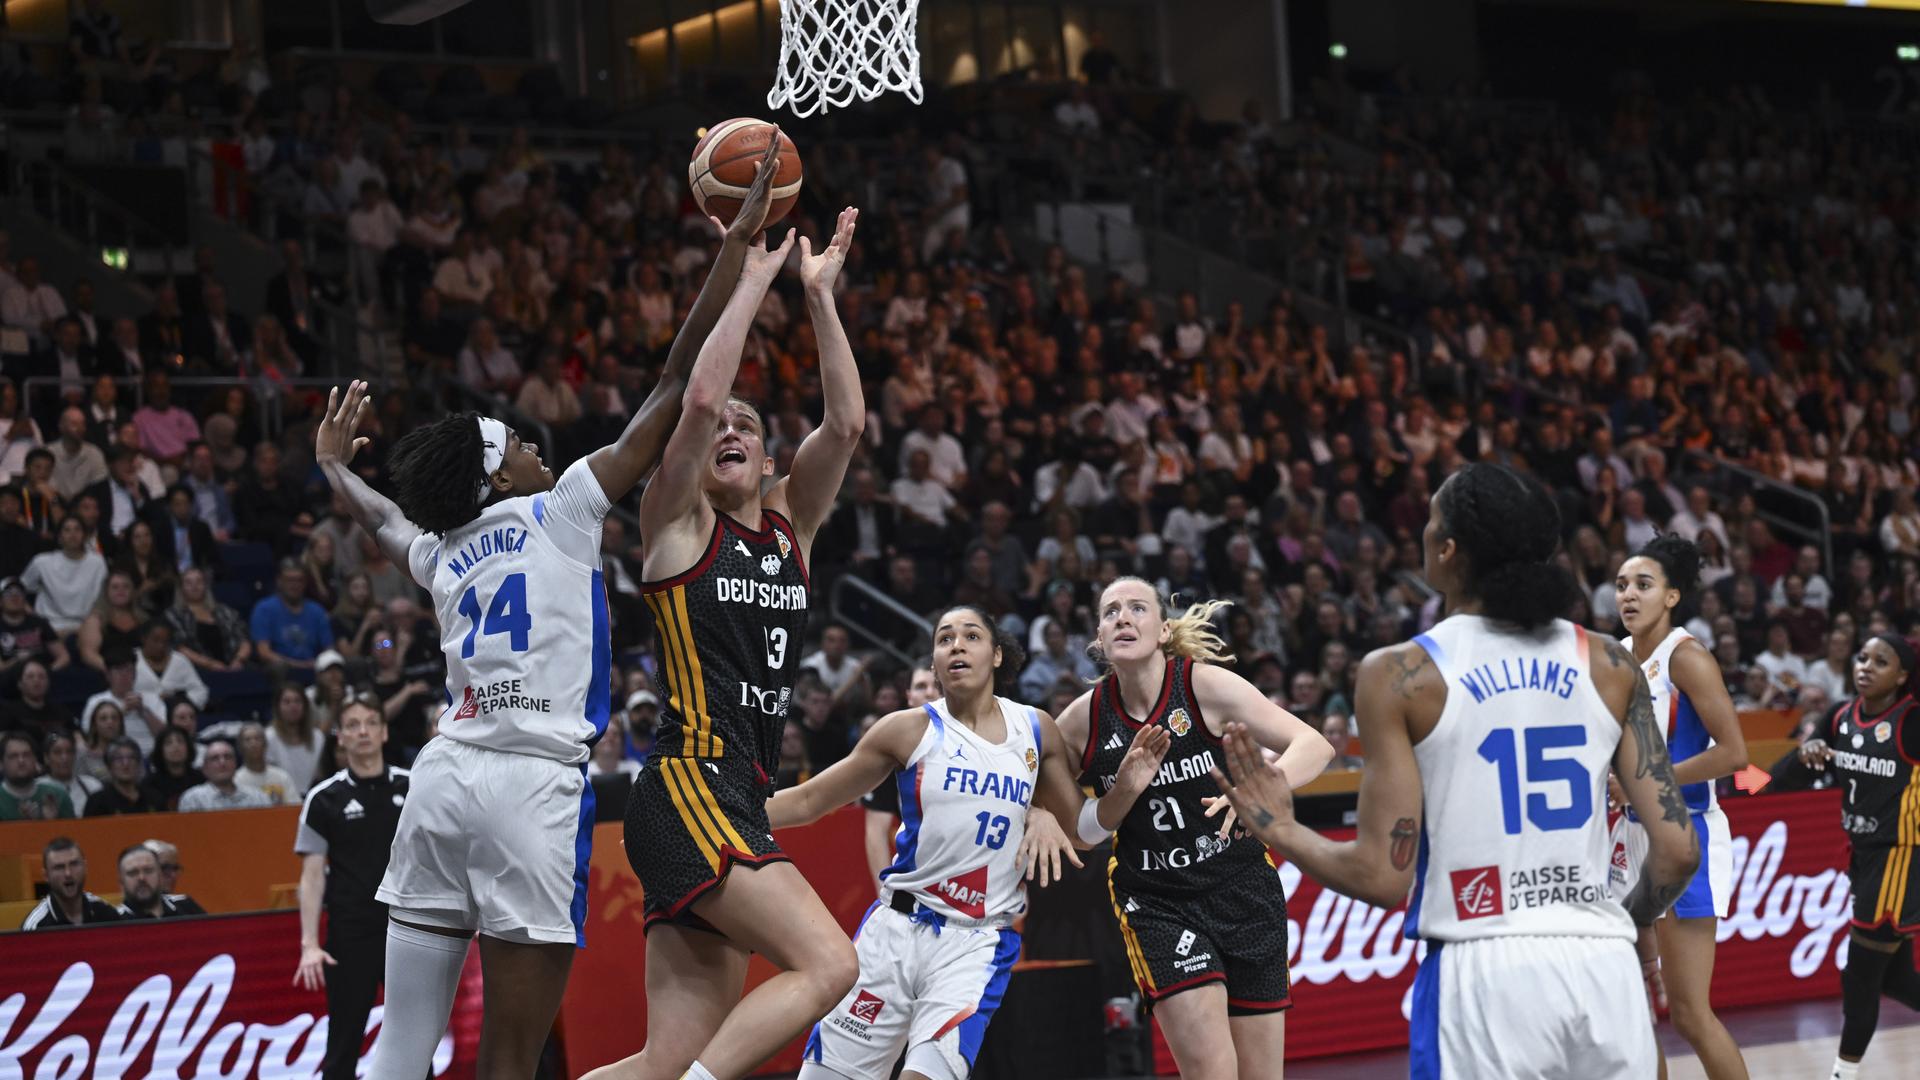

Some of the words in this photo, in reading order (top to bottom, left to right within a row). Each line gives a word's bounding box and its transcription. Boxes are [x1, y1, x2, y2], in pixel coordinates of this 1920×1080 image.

[449, 528, 528, 579] MALONGA
[458, 573, 531, 659] 14
[1460, 657, 1578, 704] WILLIAMS
[478, 695, 551, 715] 'EPARGNE
[739, 682, 778, 715] ING
[943, 767, 1032, 809] FRANC
[1477, 725, 1593, 835] 15
[1149, 796, 1186, 831] 21
[975, 811, 1011, 850] 13
[1142, 847, 1191, 871] ING
[1510, 866, 1581, 889] CAISSE
[938, 880, 985, 907] MAIF
[1173, 952, 1211, 969] Domino's
[1184, 962, 1207, 973] Pizza
[833, 1018, 873, 1041] D'EPARGNE
[845, 1016, 869, 1031] CAISSE
